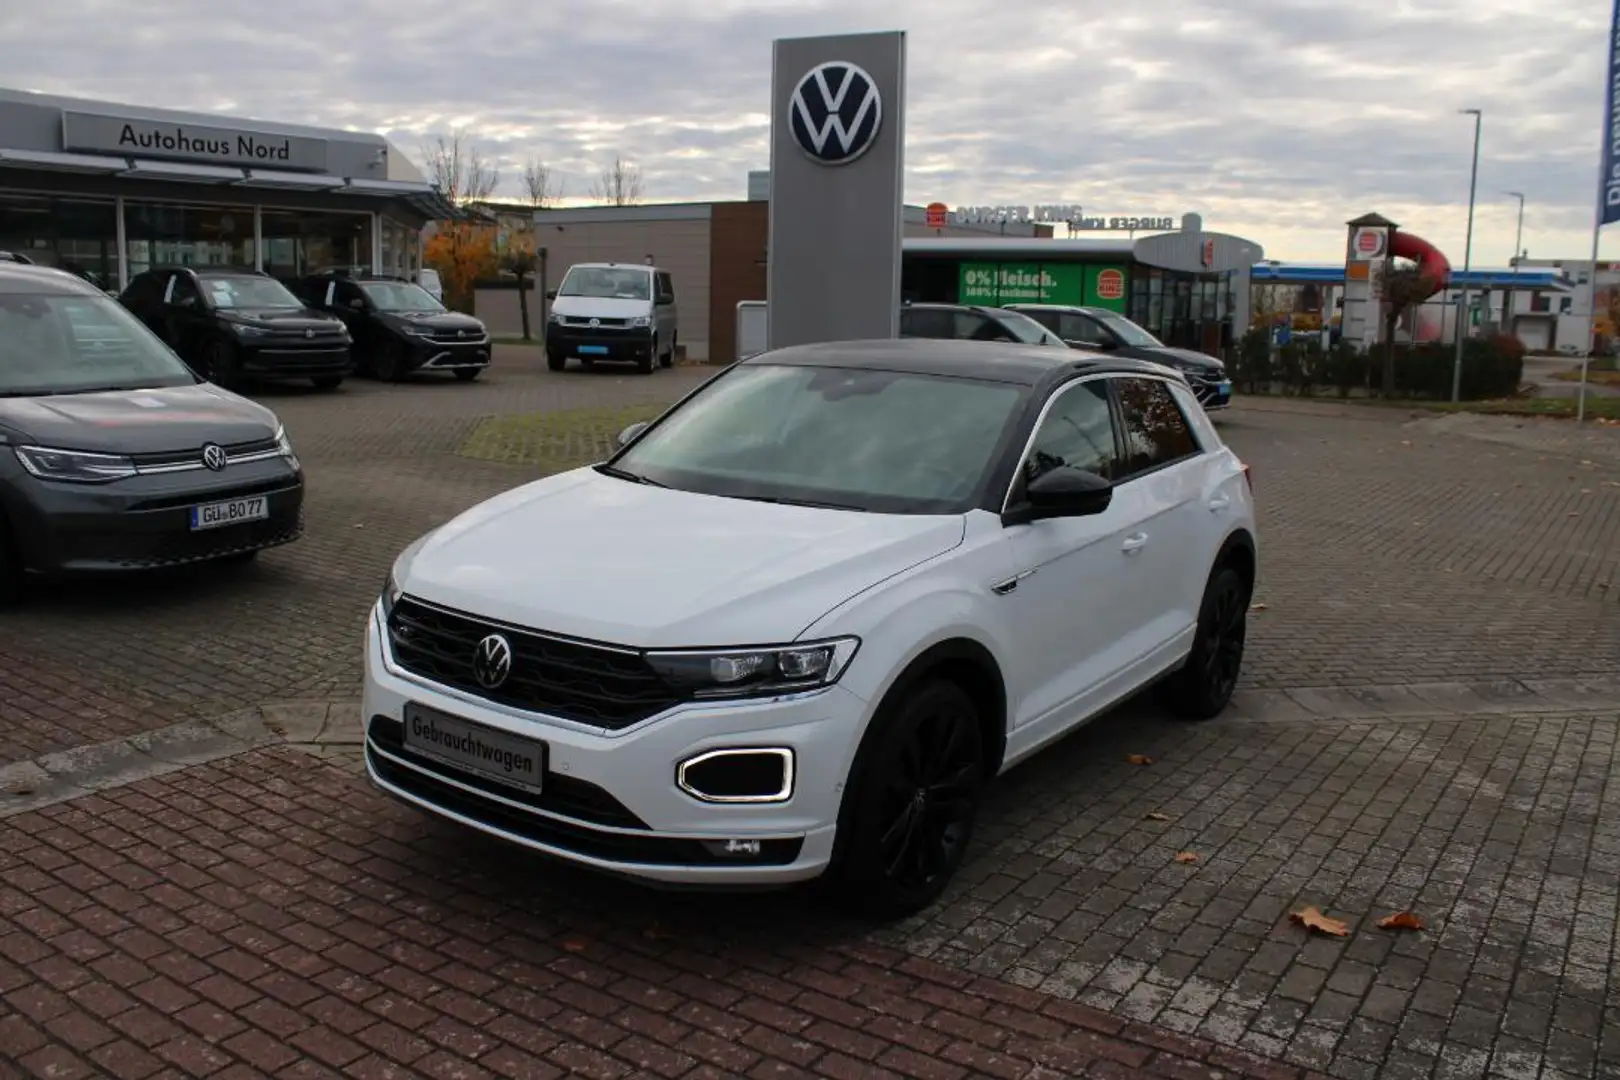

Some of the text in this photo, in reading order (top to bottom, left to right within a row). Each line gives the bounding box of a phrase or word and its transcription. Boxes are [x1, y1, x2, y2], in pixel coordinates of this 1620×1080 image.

[119, 124, 289, 160] Autohaus Nord
[965, 270, 991, 285] 0%
[204, 504, 220, 523] GÜ
[412, 715, 533, 773] Gebrauchtwagen
